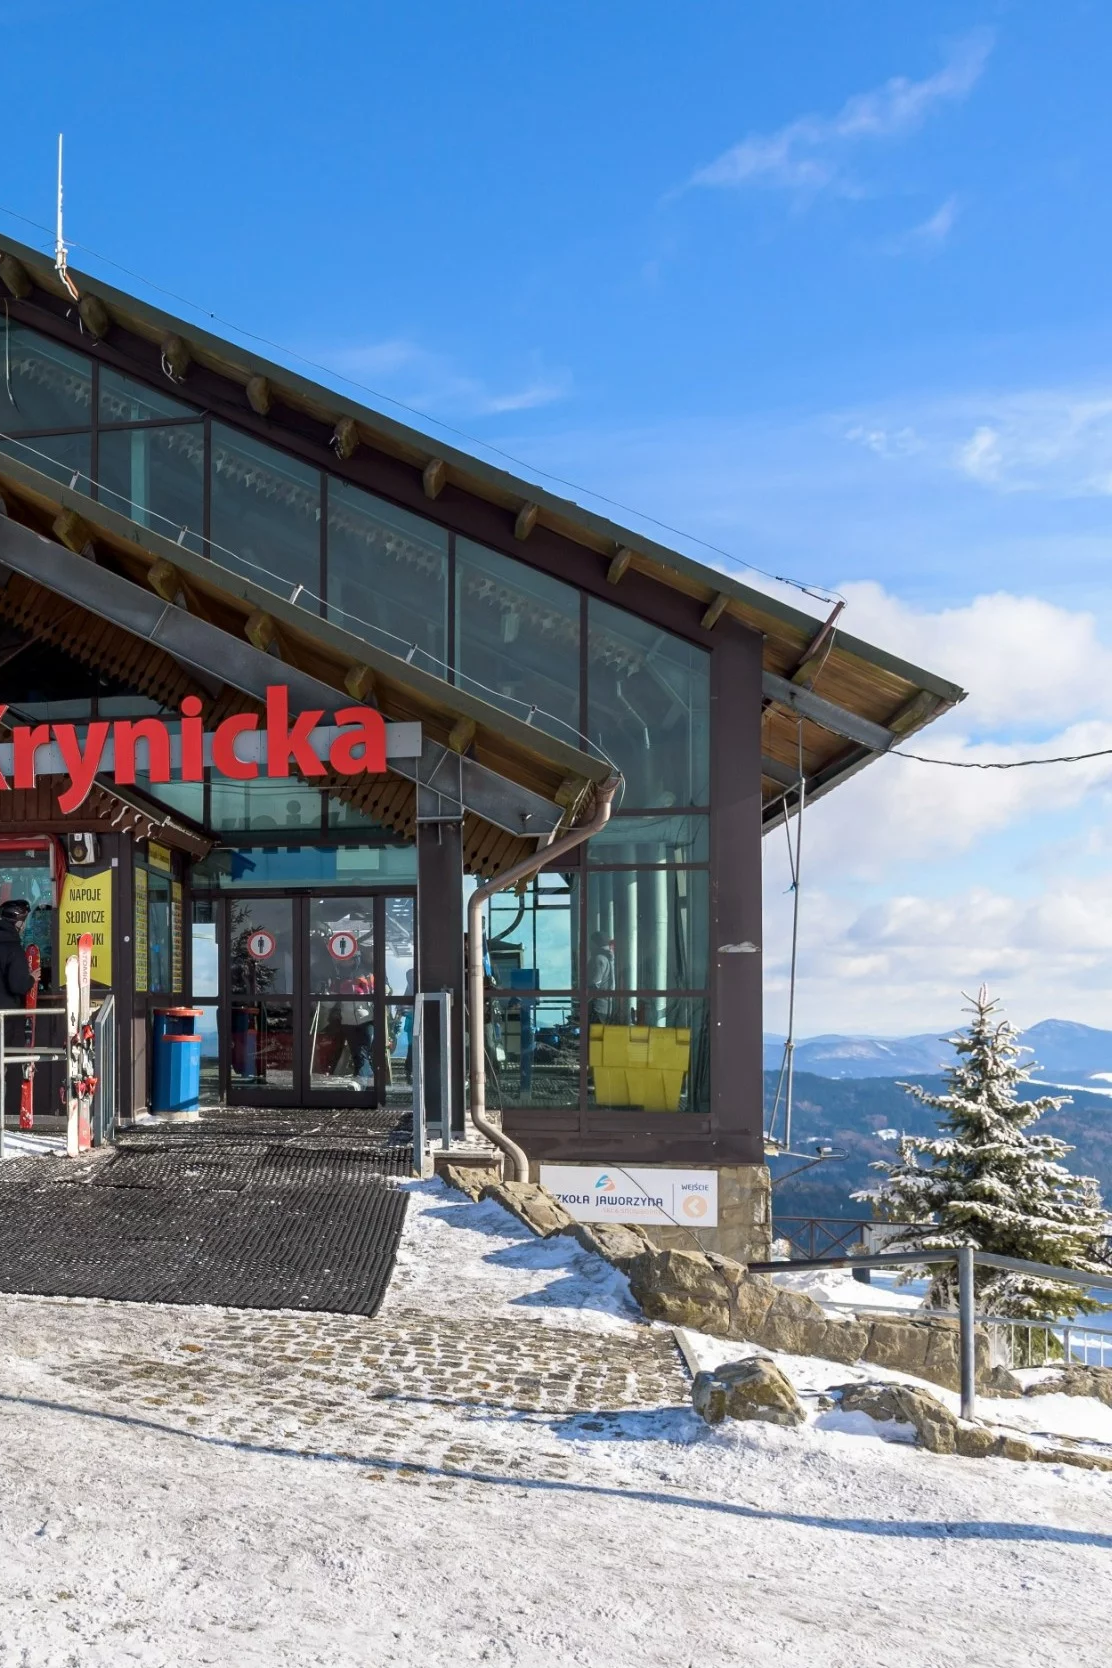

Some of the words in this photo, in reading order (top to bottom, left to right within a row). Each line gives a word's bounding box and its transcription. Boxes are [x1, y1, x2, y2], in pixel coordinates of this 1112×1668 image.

[69, 888, 102, 901] NAPOJE
[65, 910, 105, 924] SŁODYCZE
[681, 1182, 709, 1191] WEJŚCIE
[595, 1195, 663, 1207] JAWORZYNA
